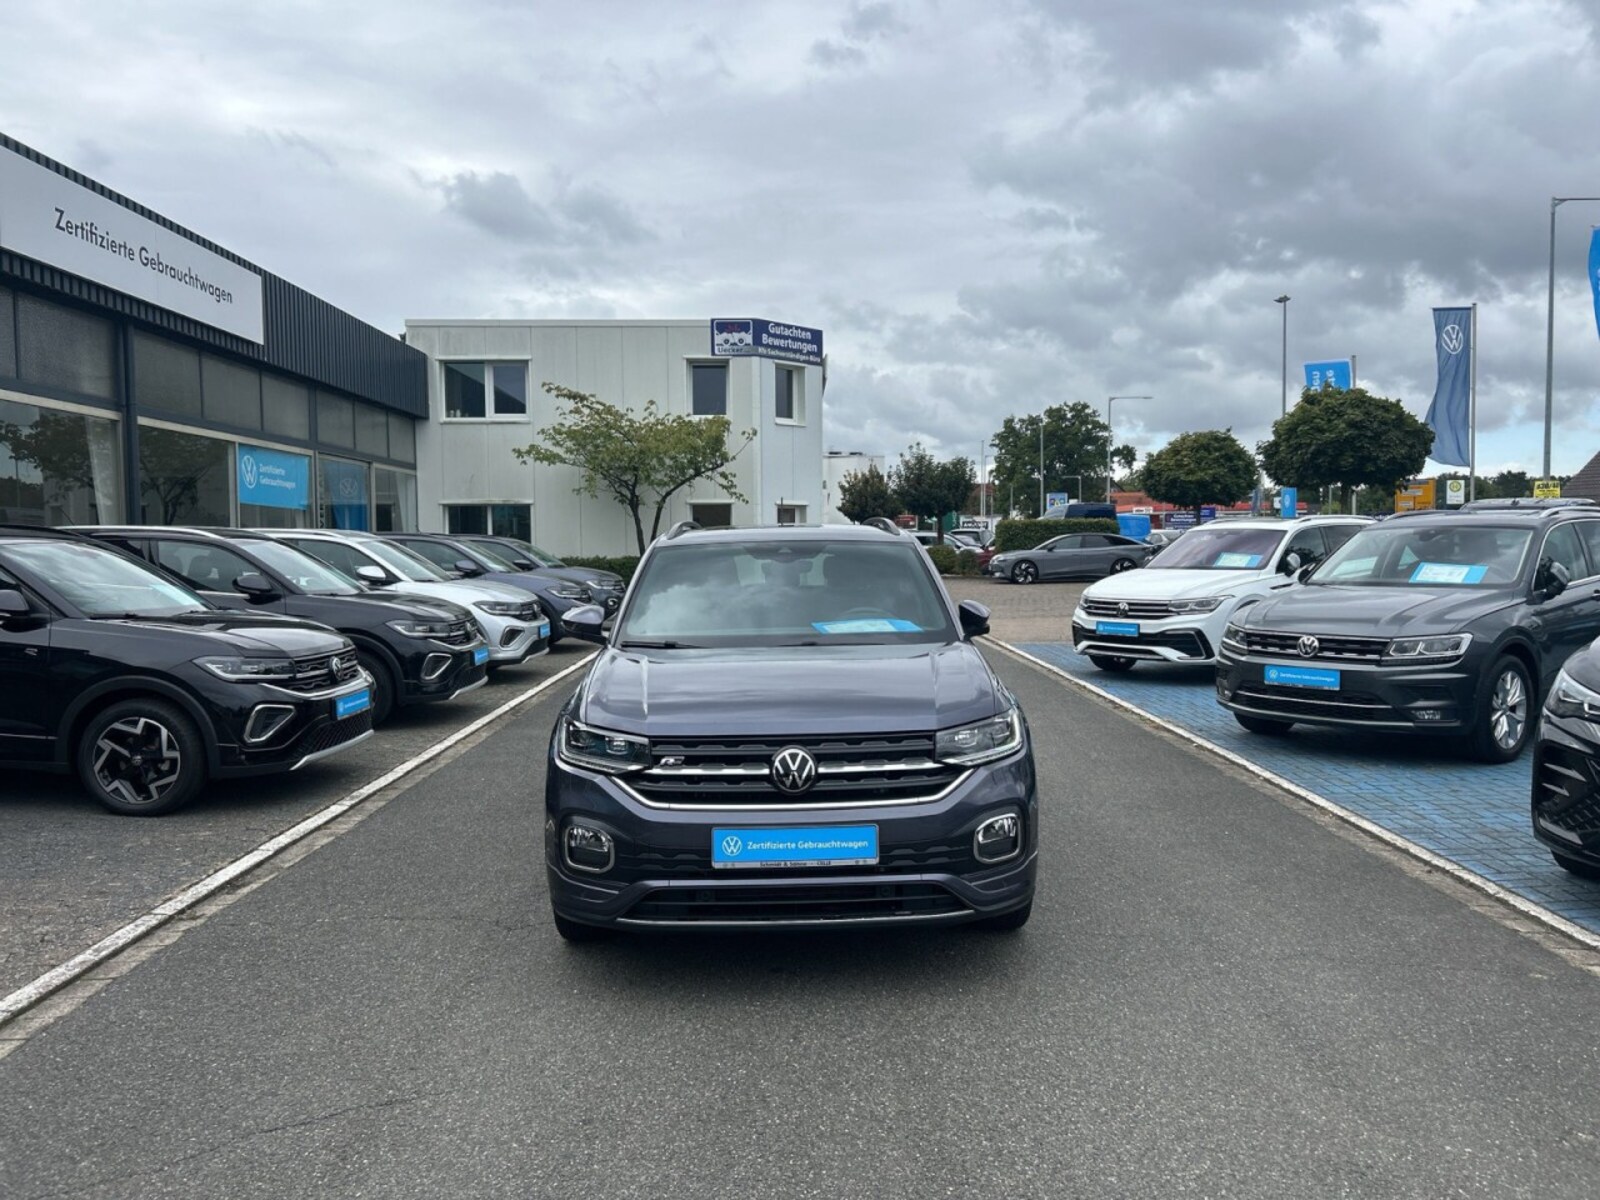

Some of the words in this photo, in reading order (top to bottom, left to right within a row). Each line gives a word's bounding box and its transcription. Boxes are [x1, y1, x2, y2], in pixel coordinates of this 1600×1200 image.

[54, 206, 135, 261] Zertifizierte
[139, 246, 233, 304] Gebrauchtwagen
[768, 323, 812, 340] Gutachten
[761, 334, 818, 353] Bewertungen
[747, 841, 796, 850] Zertifizierte
[797, 840, 869, 849] Gebrauchtwagen
